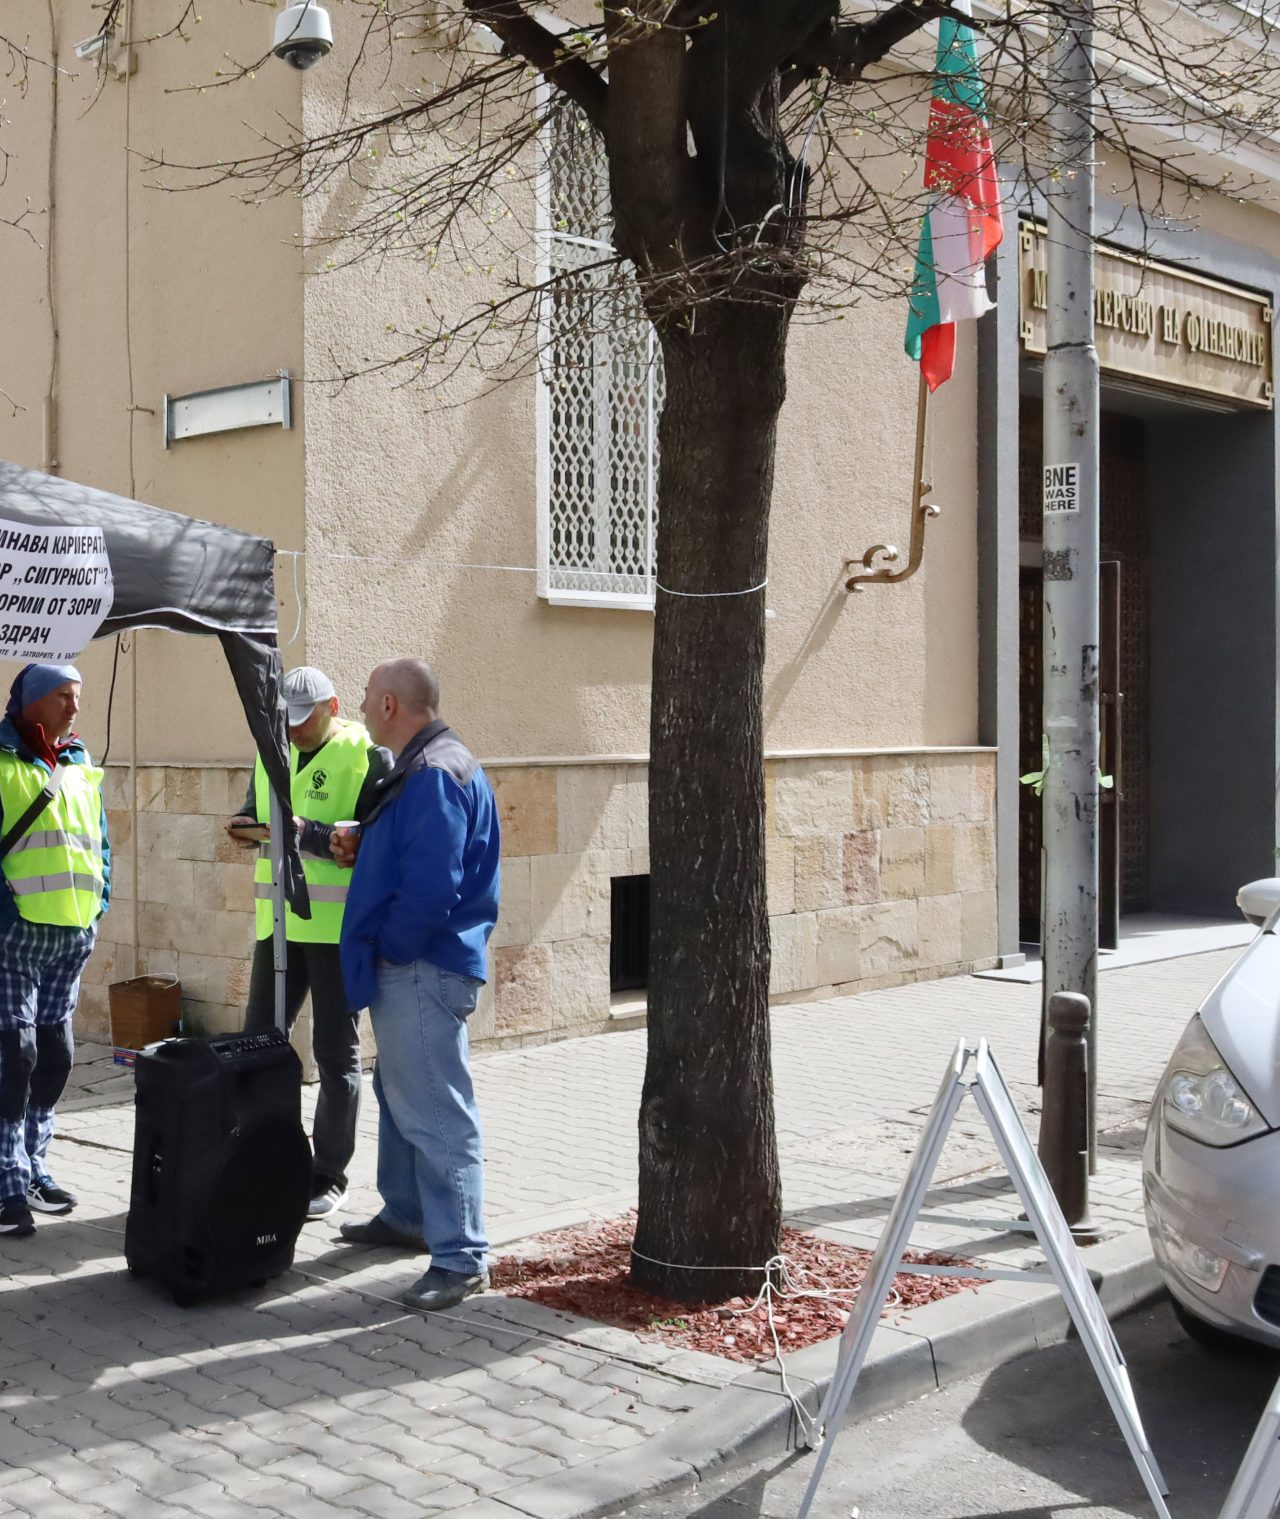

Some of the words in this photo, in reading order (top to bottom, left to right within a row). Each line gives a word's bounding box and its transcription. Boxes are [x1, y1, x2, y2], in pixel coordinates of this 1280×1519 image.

[1032, 270, 1156, 338] МТЕРСТВО
[1163, 306, 1182, 345] НА
[1186, 312, 1266, 367] ФИНАНСИТЕ
[1045, 466, 1076, 488] BNE
[1045, 487, 1076, 500] WAS
[1045, 499, 1076, 512] HERE
[47, 597, 68, 615] ОТ
[67, 598, 102, 616] ЗОРИ
[20, 650, 54, 660] ЗАТВОРИТЕ
